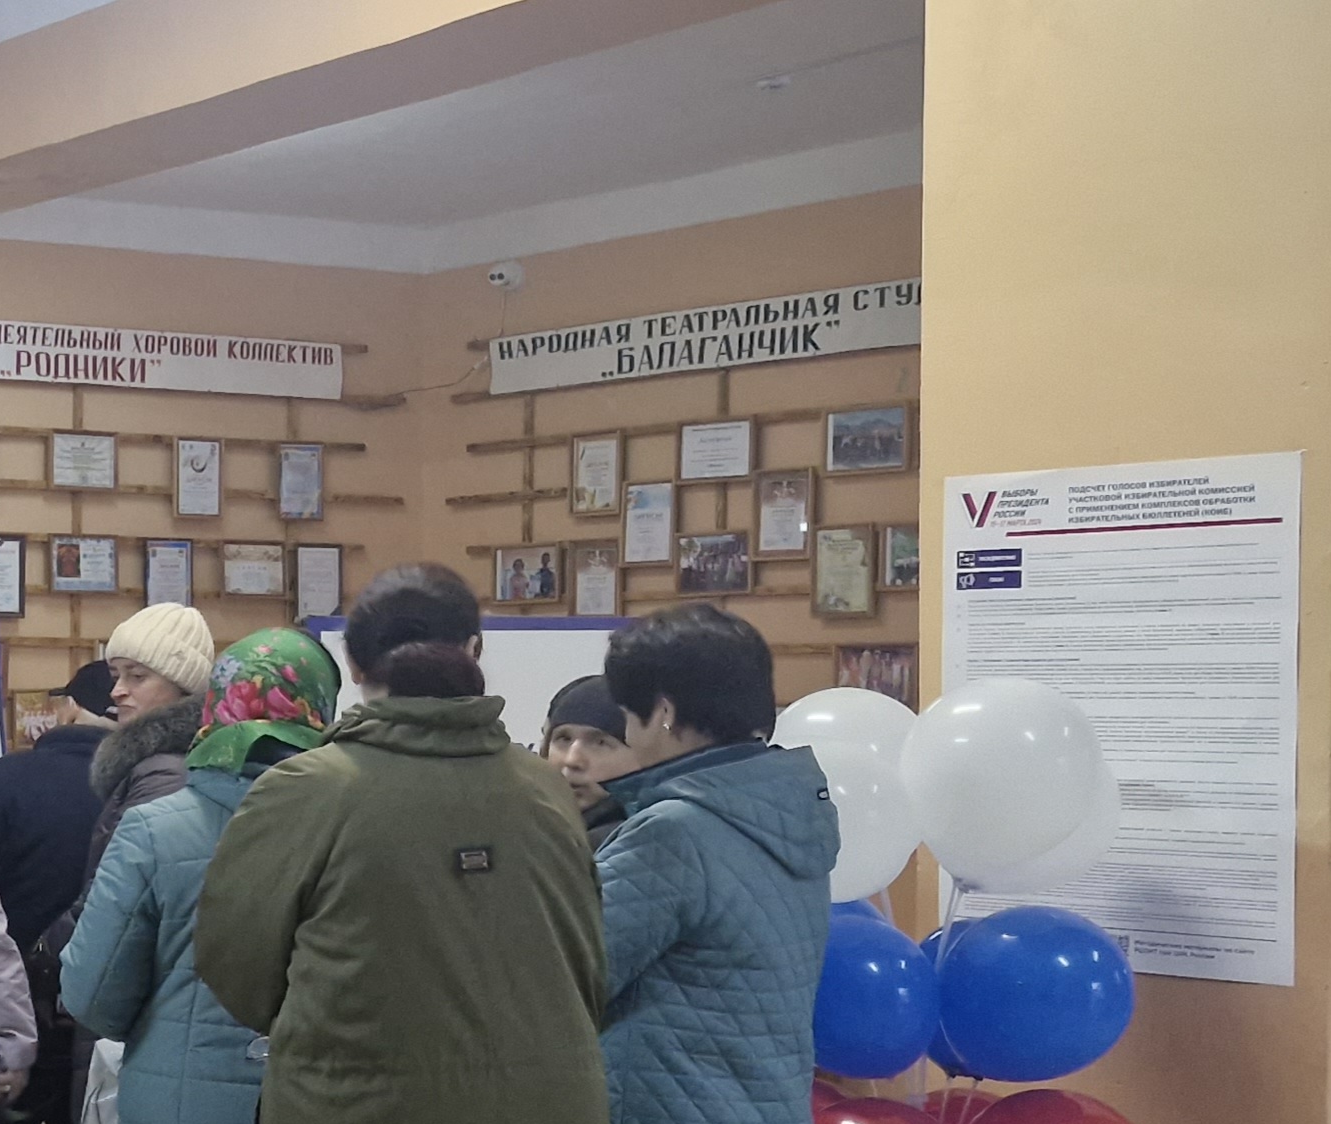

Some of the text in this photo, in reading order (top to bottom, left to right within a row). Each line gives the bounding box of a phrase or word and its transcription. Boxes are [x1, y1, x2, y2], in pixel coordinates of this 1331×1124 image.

[498, 322, 632, 361] НАРОДНАЯ
[643, 292, 840, 339] ТЕАТРАЛЬНАЯ
[133, 331, 218, 358] ХОРОВОЙ
[227, 339, 334, 366] КОЛЛЕКТИВ
[1001, 488, 1038, 498] ВЫБОРЫ
[1068, 476, 1209, 494] ПОДСЧЕТ ГОЛОСОВ ИЗБИРАТЕЛЕЙ
[1068, 484, 1255, 504] УЧАСТКОВОЙ ИЗБИРАТЕЛЬНОЙ КОМИССИЕЙ
[997, 498, 1049, 508] ПРЕЗИДЕНТА
[1075, 503, 1139, 513] ПРИМЕНЕНИЕМ
[1141, 499, 1200, 509] КОМПЛЕКСОВ
[1202, 496, 1256, 506] ОБРАБОТКИ
[993, 509, 1027, 518] РОССИИ
[1068, 513, 1141, 523] ИЗБИРАТЕЛЬНЫХ
[1142, 509, 1199, 520] БЮЛЛЕТЕНЕЙ
